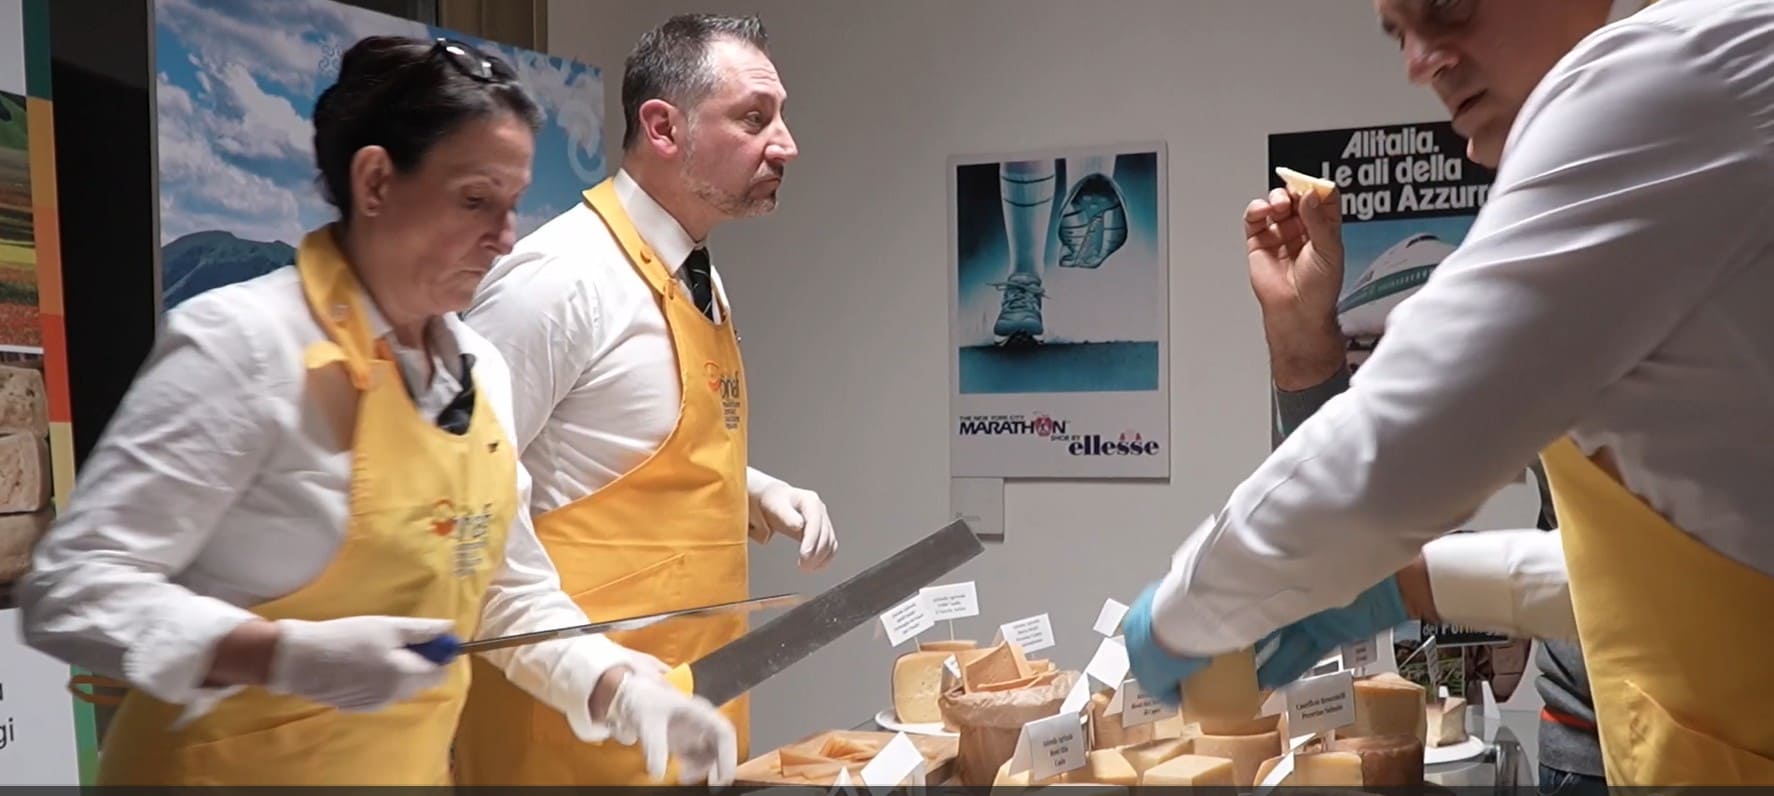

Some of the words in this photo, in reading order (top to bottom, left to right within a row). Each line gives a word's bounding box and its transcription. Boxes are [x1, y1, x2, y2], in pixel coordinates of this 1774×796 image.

[1341, 127, 1440, 159] Alitalia.
[1321, 161, 1352, 188] Le
[1358, 158, 1389, 184] ali
[1395, 154, 1462, 183] della
[1341, 190, 1391, 220] nga
[1397, 184, 1489, 212] Azzurr
[1068, 434, 1160, 456] ellesse
